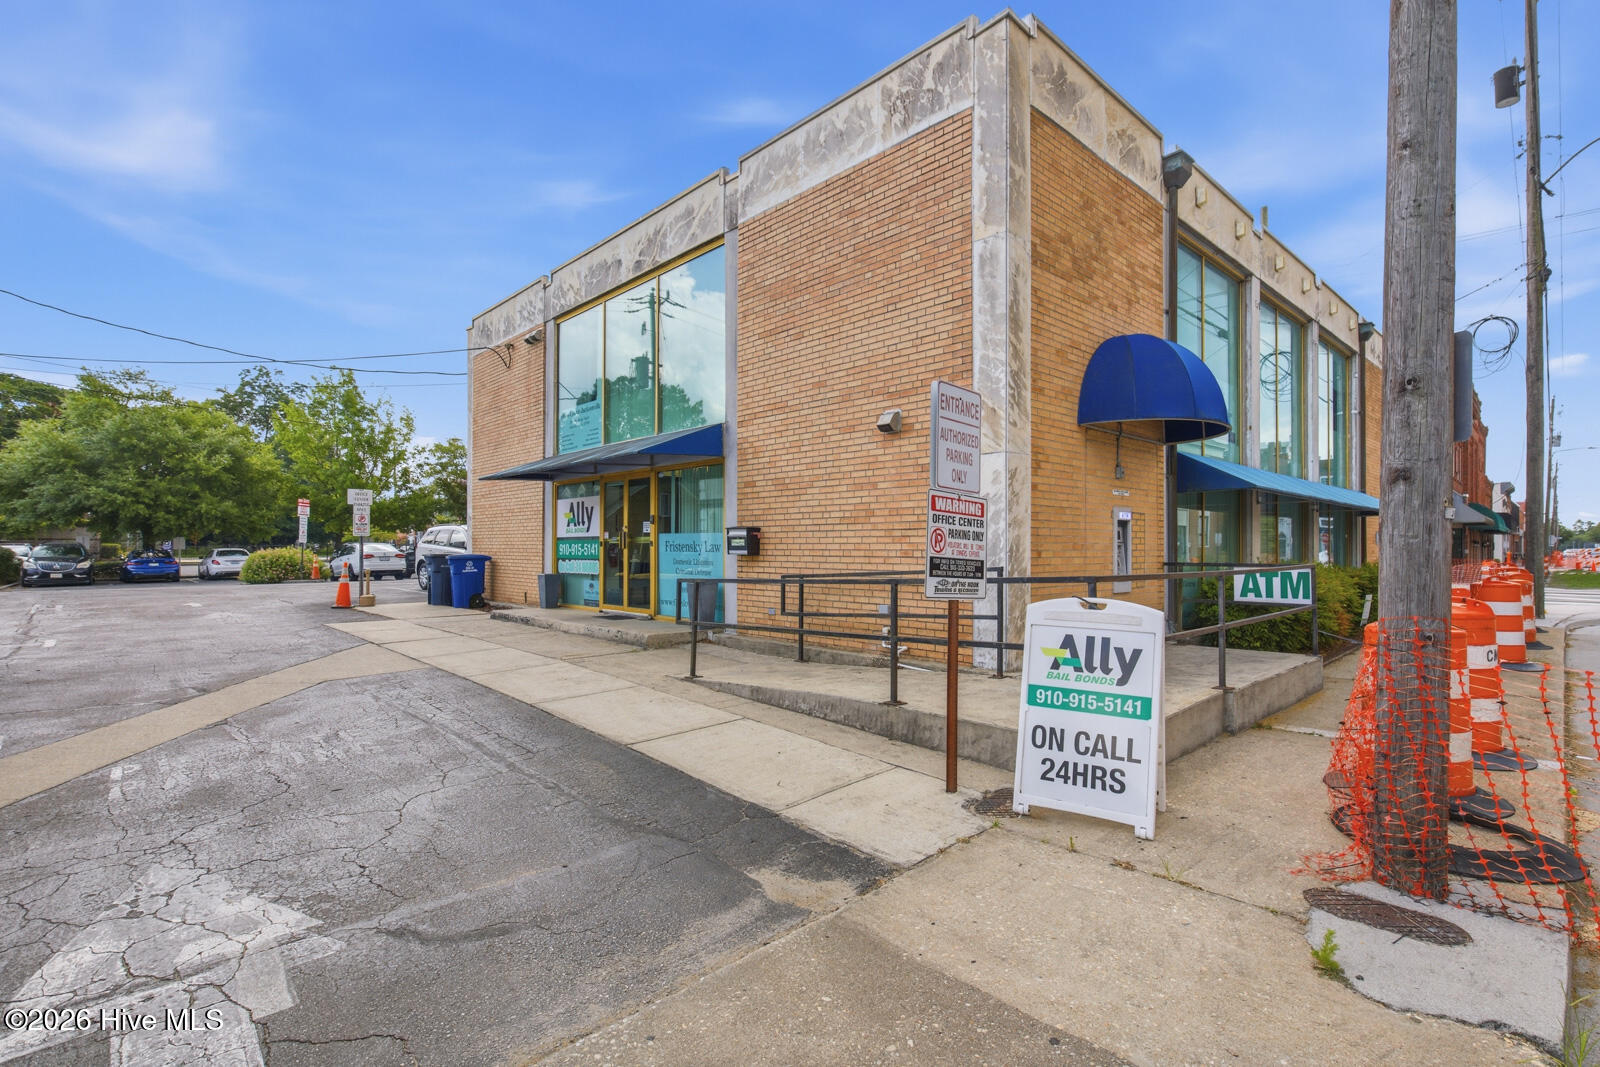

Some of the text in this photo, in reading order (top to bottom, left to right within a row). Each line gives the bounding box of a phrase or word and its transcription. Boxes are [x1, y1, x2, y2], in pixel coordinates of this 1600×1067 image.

[940, 393, 979, 420] ENTRANCE
[940, 427, 979, 449] AUTHORIZED
[946, 447, 973, 466] PARKING
[951, 468, 968, 484] ONLY
[935, 496, 982, 516] WARNING
[564, 501, 594, 533] Ally
[932, 514, 984, 529] OFFICE CENTER
[948, 528, 984, 542] PARKING ONLY
[559, 544, 598, 556] 910-915-5141
[664, 540, 702, 556] Fristensky
[704, 540, 721, 552] Law
[1240, 572, 1310, 600] ATM
[1041, 634, 1143, 687] Ally
[1046, 671, 1116, 686] BAIL BONDS
[1036, 689, 1142, 716] 910-915-5141
[1031, 724, 1141, 764] ON CALL
[1040, 758, 1126, 794] 24HRS
